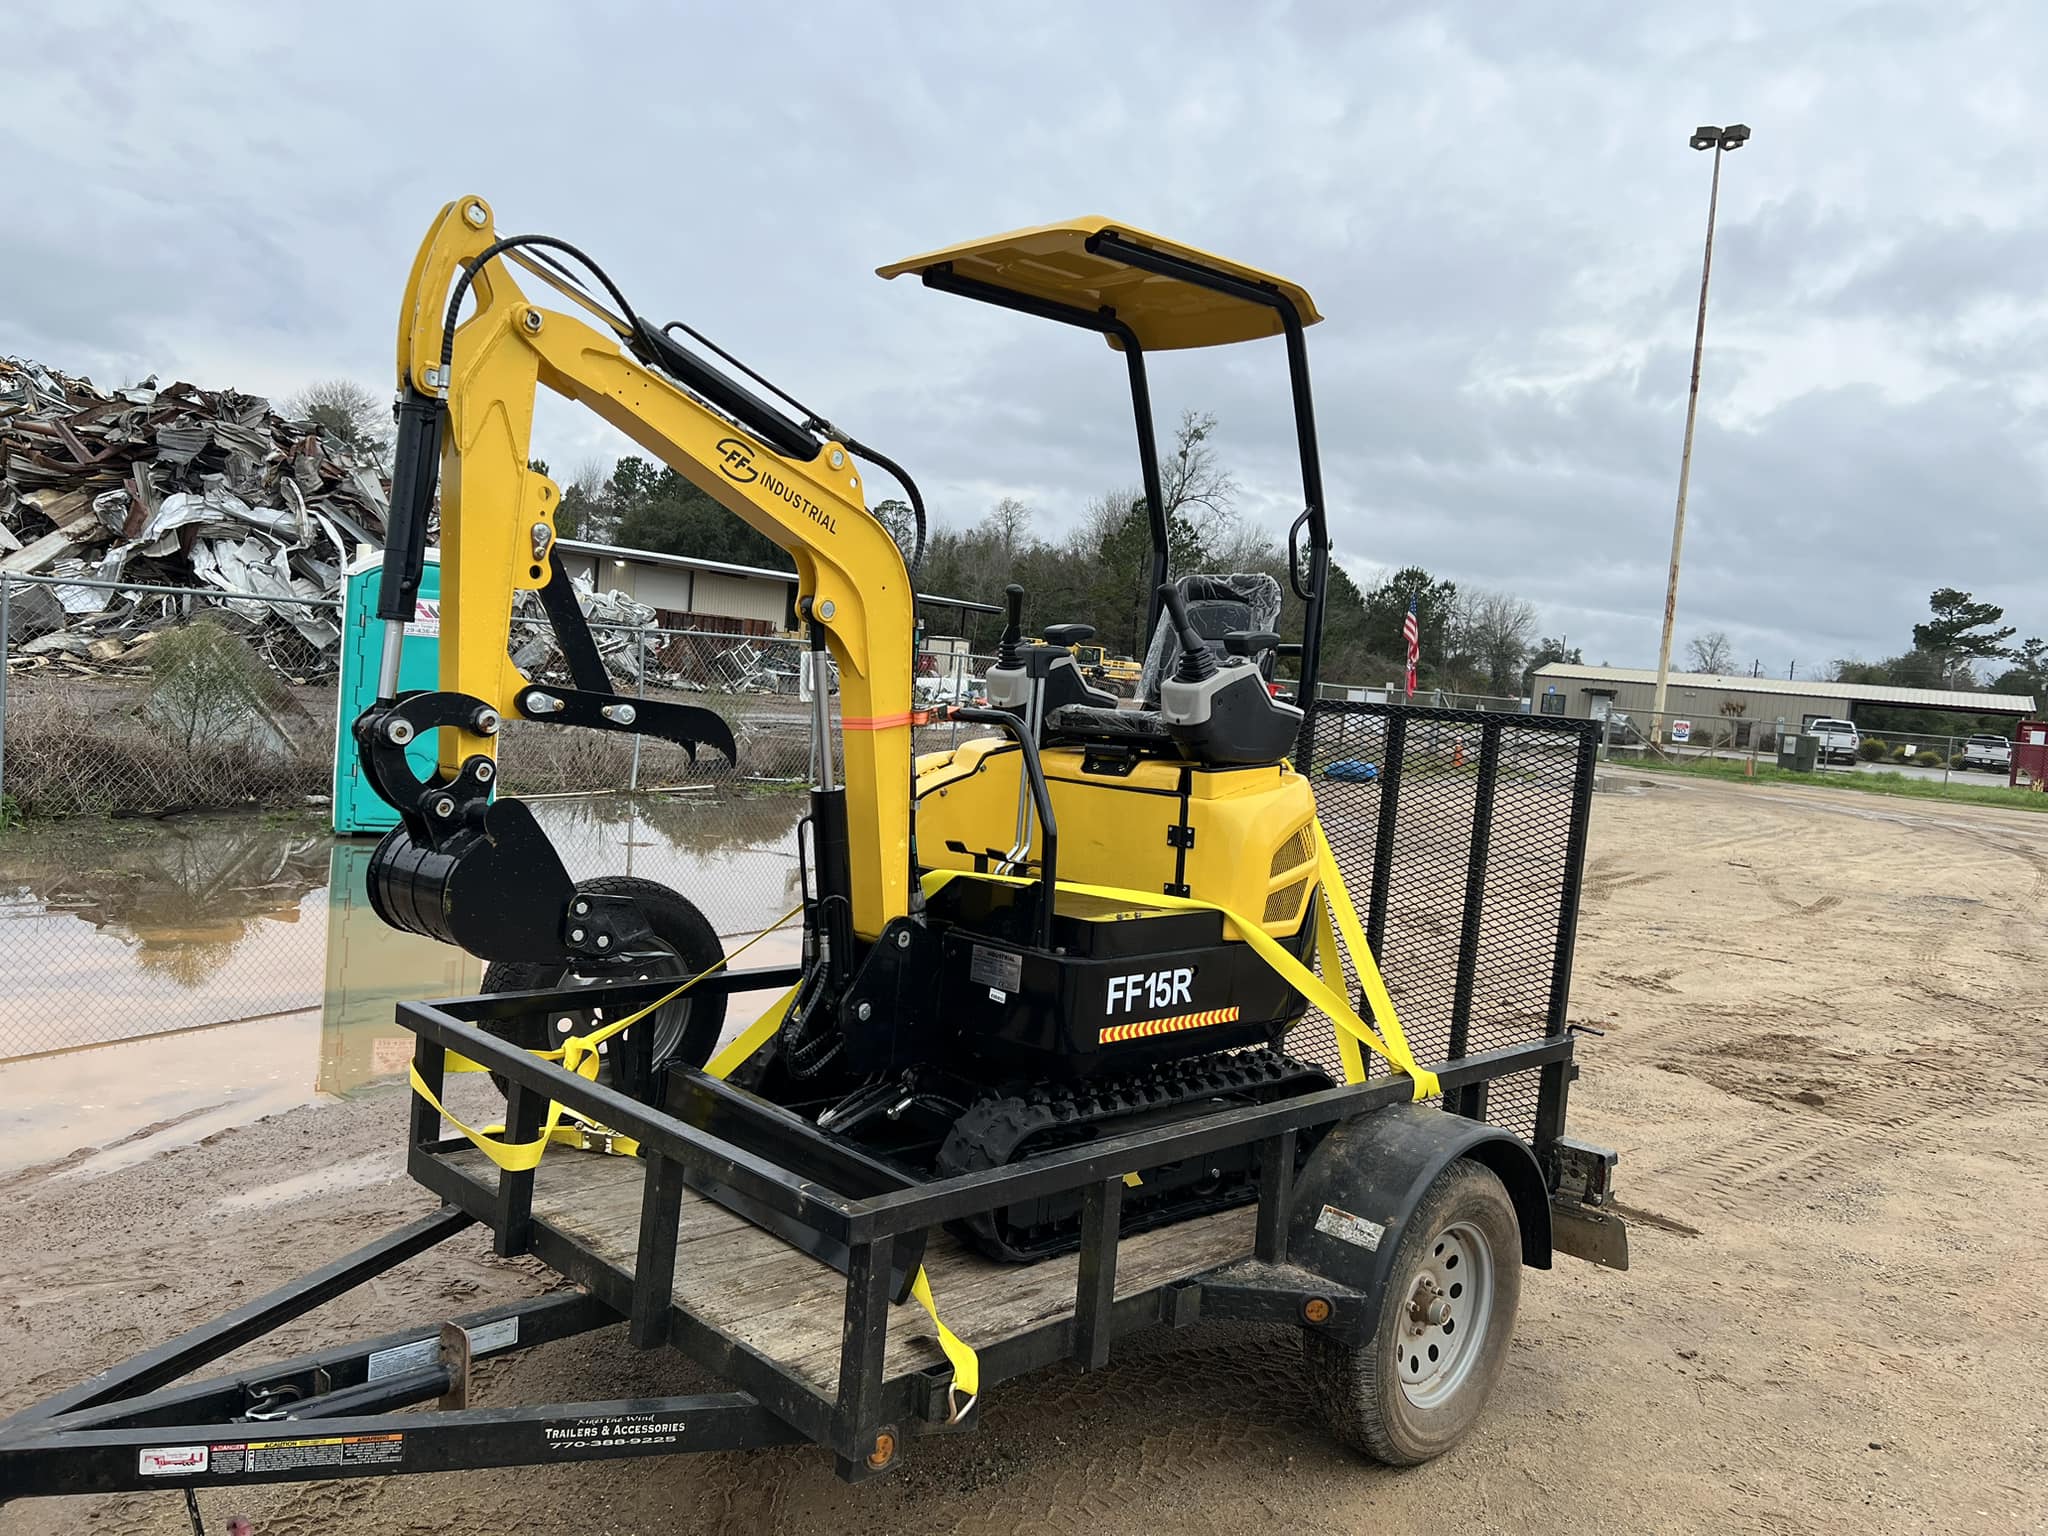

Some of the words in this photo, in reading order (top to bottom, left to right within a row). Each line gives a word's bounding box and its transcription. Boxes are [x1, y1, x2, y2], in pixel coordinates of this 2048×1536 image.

[760, 472, 837, 535] INDUSTRIAL
[1106, 967, 1193, 1015] FF15R
[627, 1414, 655, 1422] Wind
[545, 1427, 598, 1439] TRAILERS
[601, 1425, 610, 1436] &
[613, 1423, 686, 1435] ACCESSORIES
[550, 1436, 677, 1449] 770-388-9225
